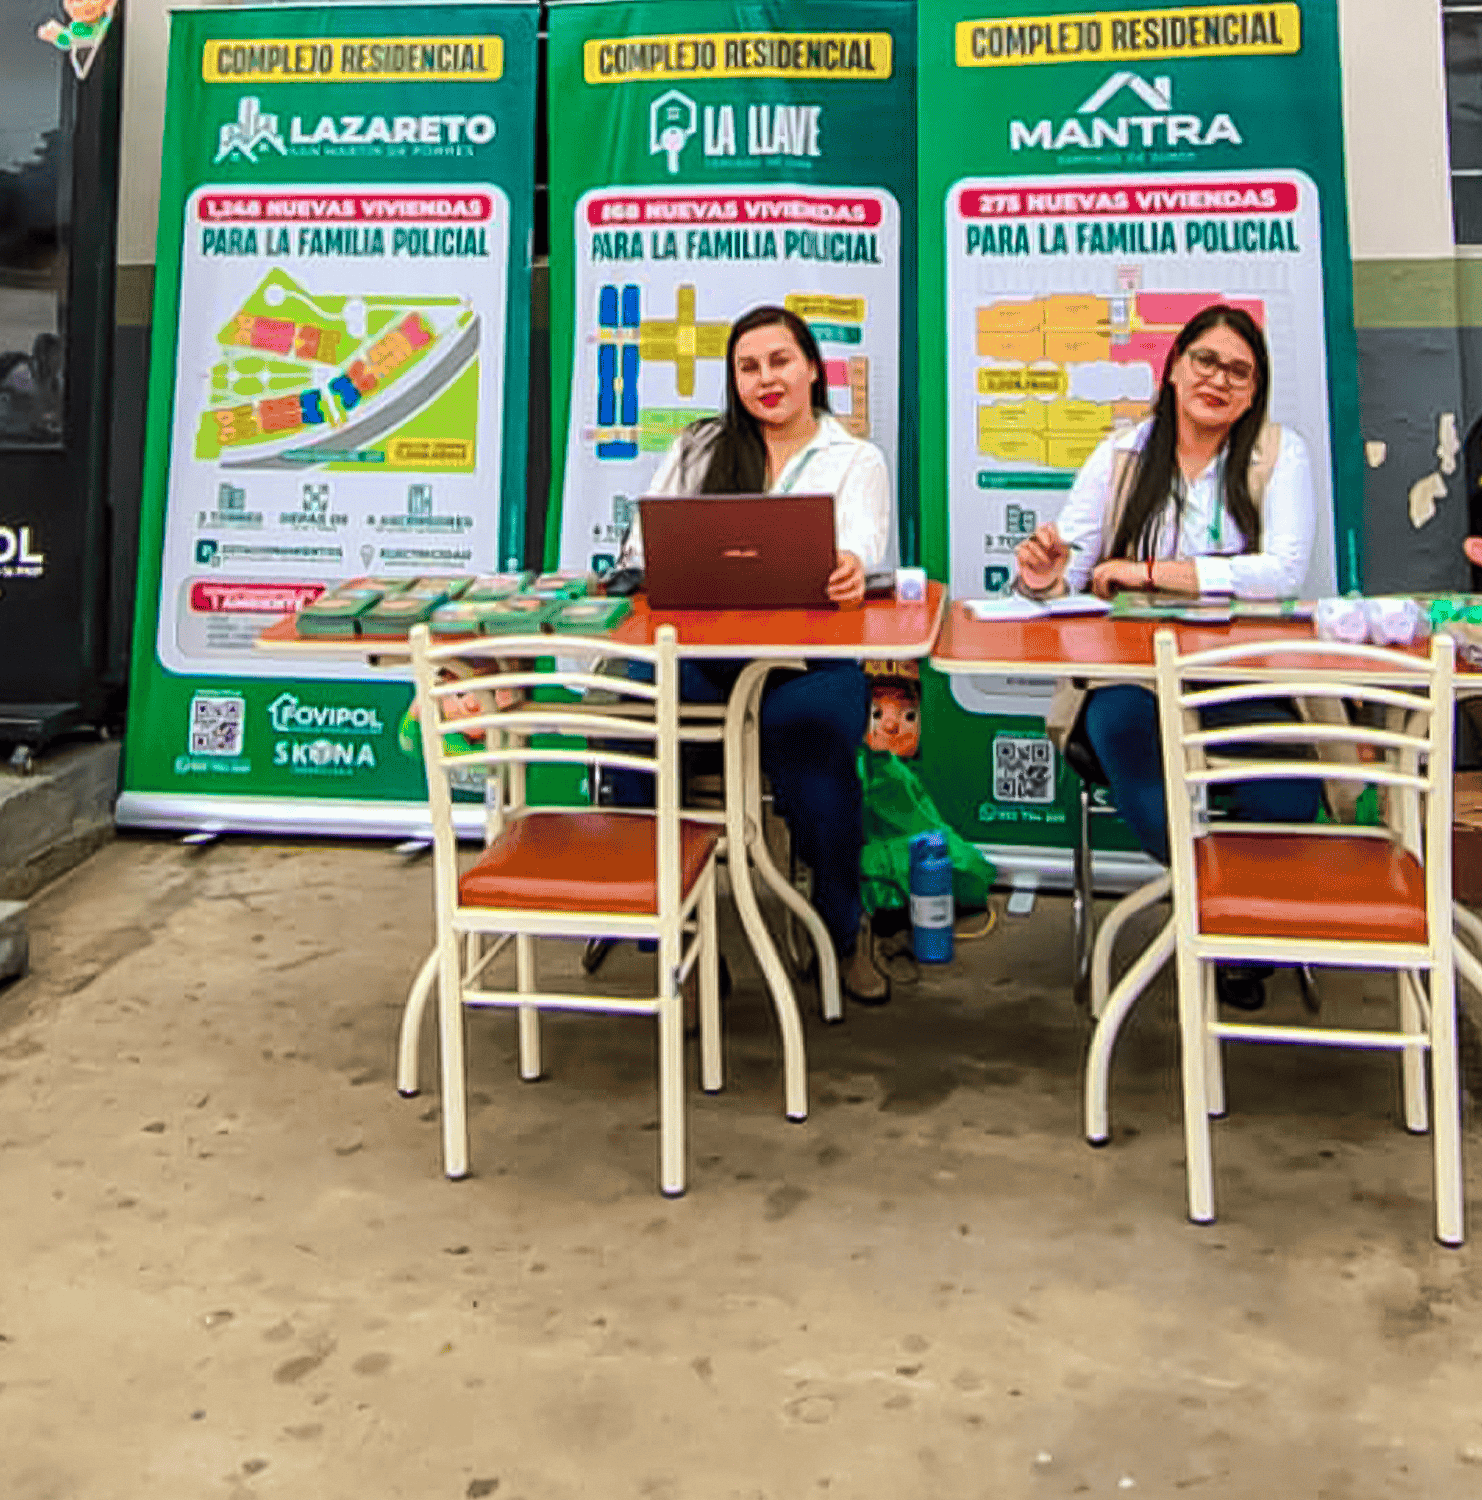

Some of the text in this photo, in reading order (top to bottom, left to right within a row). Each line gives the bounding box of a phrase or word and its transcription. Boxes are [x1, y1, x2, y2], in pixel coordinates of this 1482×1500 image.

[972, 11, 1284, 58] COMPLEJO RESIDENCIAL
[218, 44, 488, 76] COMPLEJO RESIDENCIAL
[600, 38, 875, 74] COMPLEJO RESIDENCIAL
[291, 115, 496, 144] LAZARETO
[705, 106, 822, 156] LA LLAVE
[1009, 114, 1243, 152] MANTRA
[267, 200, 355, 216] NUEVAS
[360, 200, 482, 216] VIVIENDAS
[646, 201, 739, 219] NUEVAS
[743, 201, 867, 220] VIVIENDAS
[1028, 192, 1130, 212] NUEVAS
[1134, 189, 1278, 210] VIVIENDAS
[202, 227, 490, 256] PARA LA FAMILIA POLICIAL
[592, 229, 883, 264] PARA LA FAMILIA POLICIAL
[967, 218, 1301, 256] PARA LA FAMILIA POLICIAL
[282, 706, 384, 728] FOVIPOL
